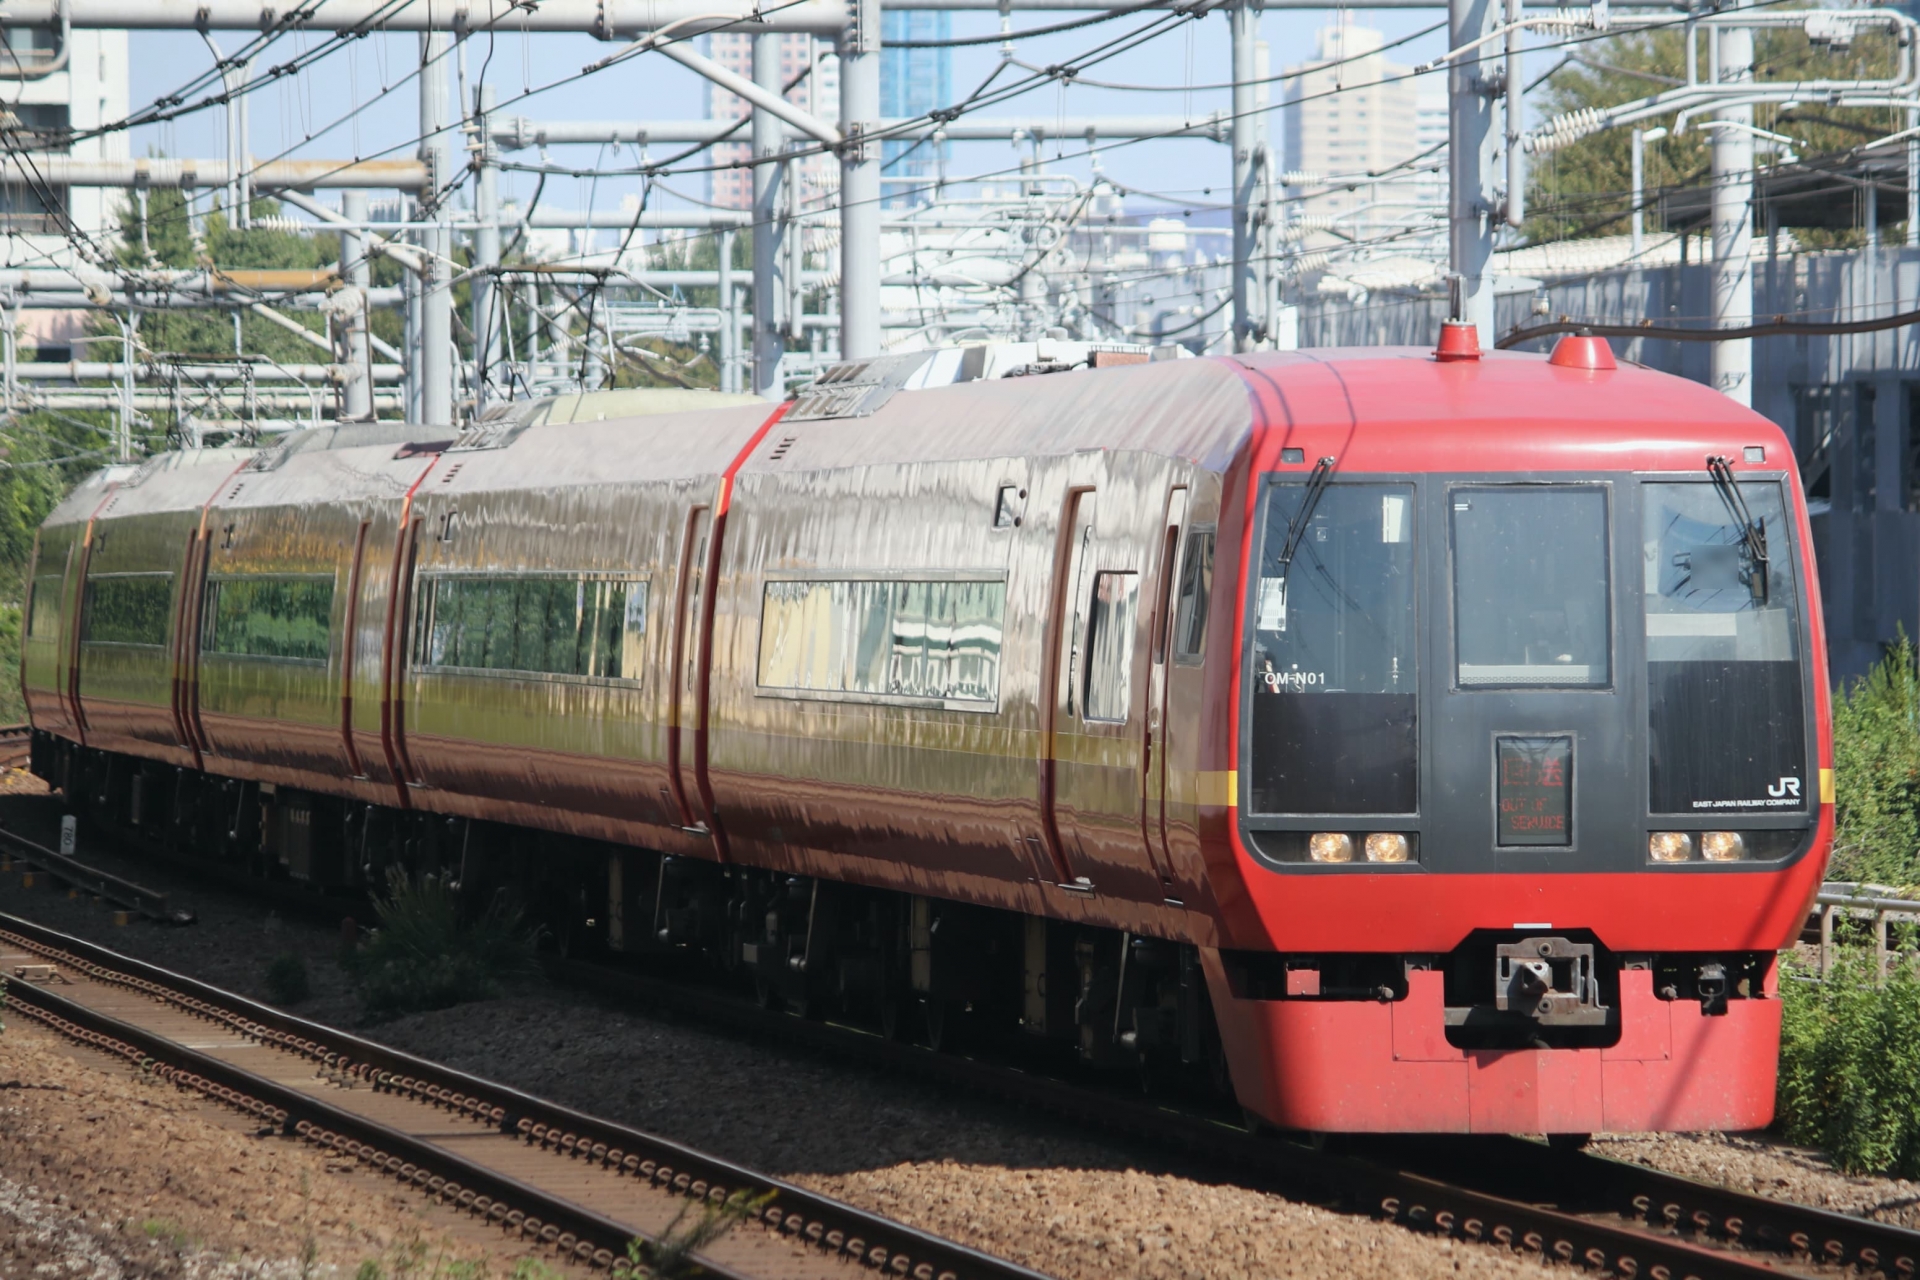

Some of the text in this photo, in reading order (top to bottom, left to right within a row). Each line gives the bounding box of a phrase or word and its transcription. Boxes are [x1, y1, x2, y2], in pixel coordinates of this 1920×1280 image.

[1265, 672, 1324, 684] OM-N01
[1768, 777, 1800, 797] JR
[1693, 800, 1713, 808] EAST
[1737, 799, 1766, 807] RAILWAY
[1766, 798, 1800, 806] COMPANY
